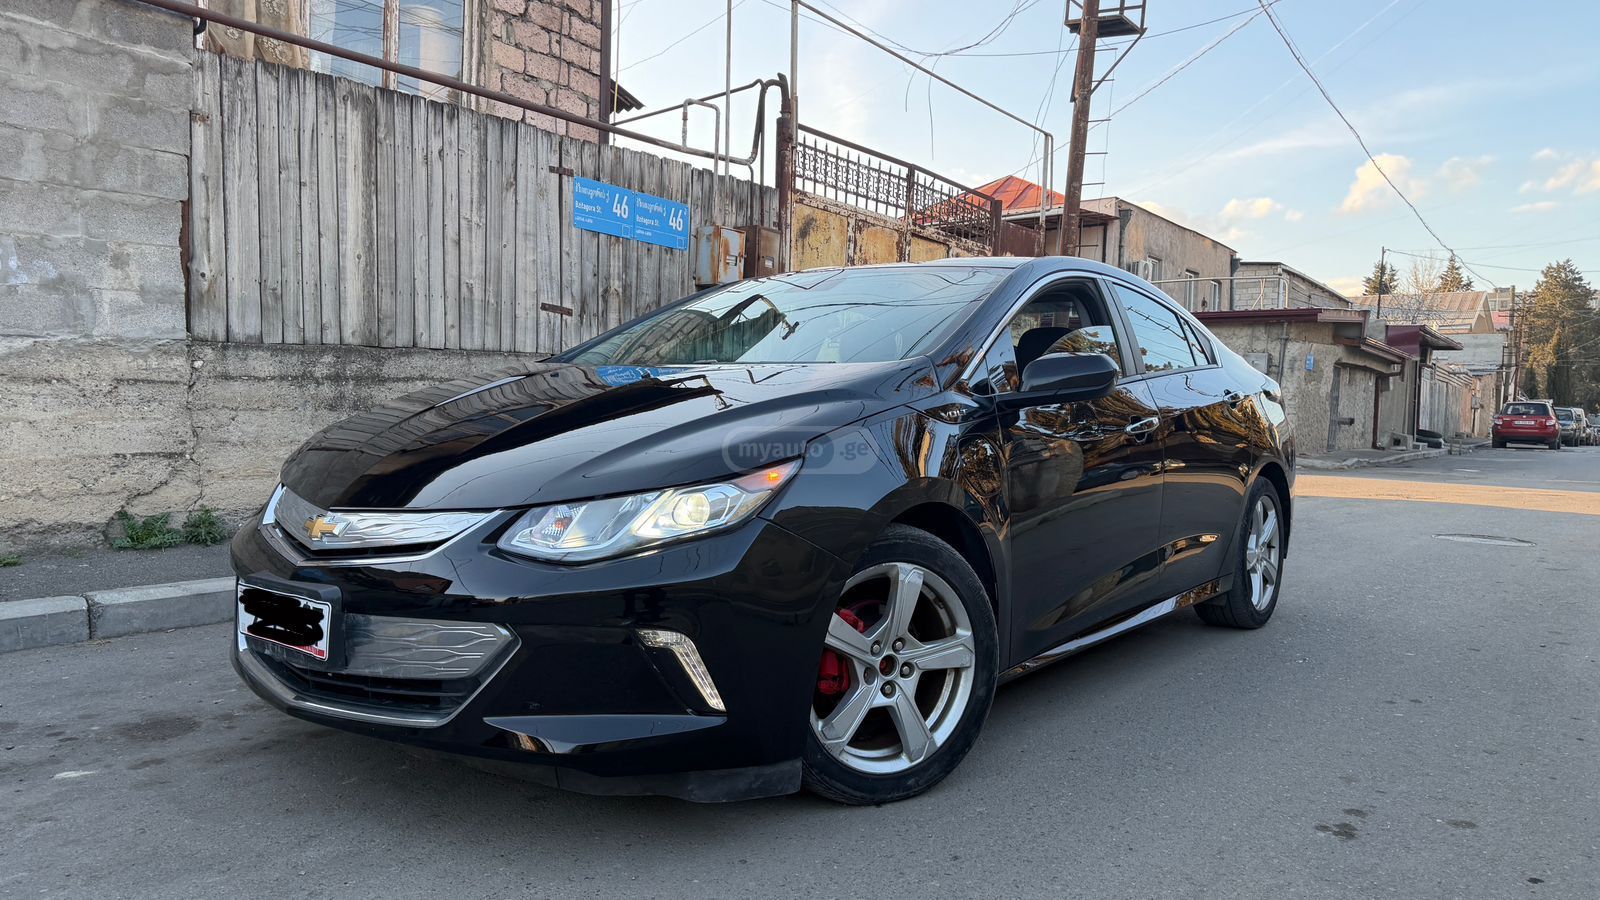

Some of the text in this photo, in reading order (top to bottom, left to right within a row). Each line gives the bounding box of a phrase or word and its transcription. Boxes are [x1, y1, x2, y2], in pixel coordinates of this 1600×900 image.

[612, 193, 629, 219] 46
[669, 207, 684, 231] 46
[939, 409, 967, 419] VOLT
